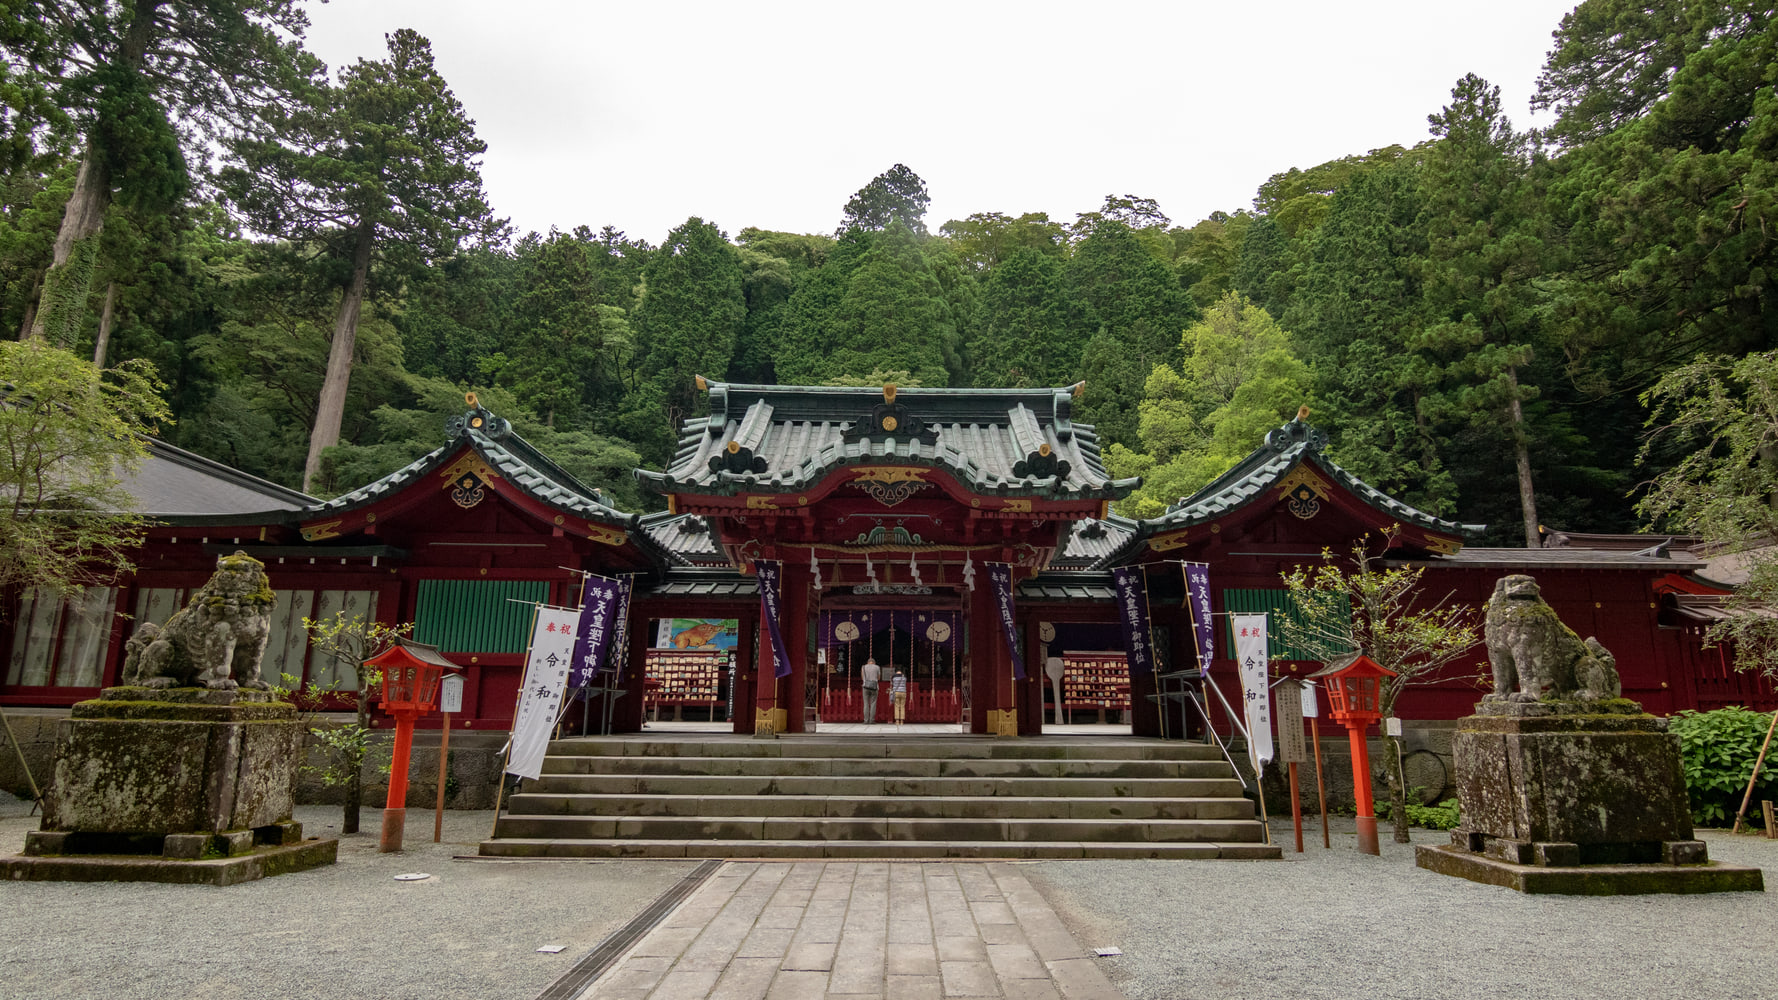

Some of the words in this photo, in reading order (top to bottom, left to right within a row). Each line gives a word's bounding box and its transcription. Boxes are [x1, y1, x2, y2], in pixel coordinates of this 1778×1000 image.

[545, 621, 571, 635] 奉祝
[535, 652, 559, 699] 令和
[1244, 656, 1257, 702] 令和
